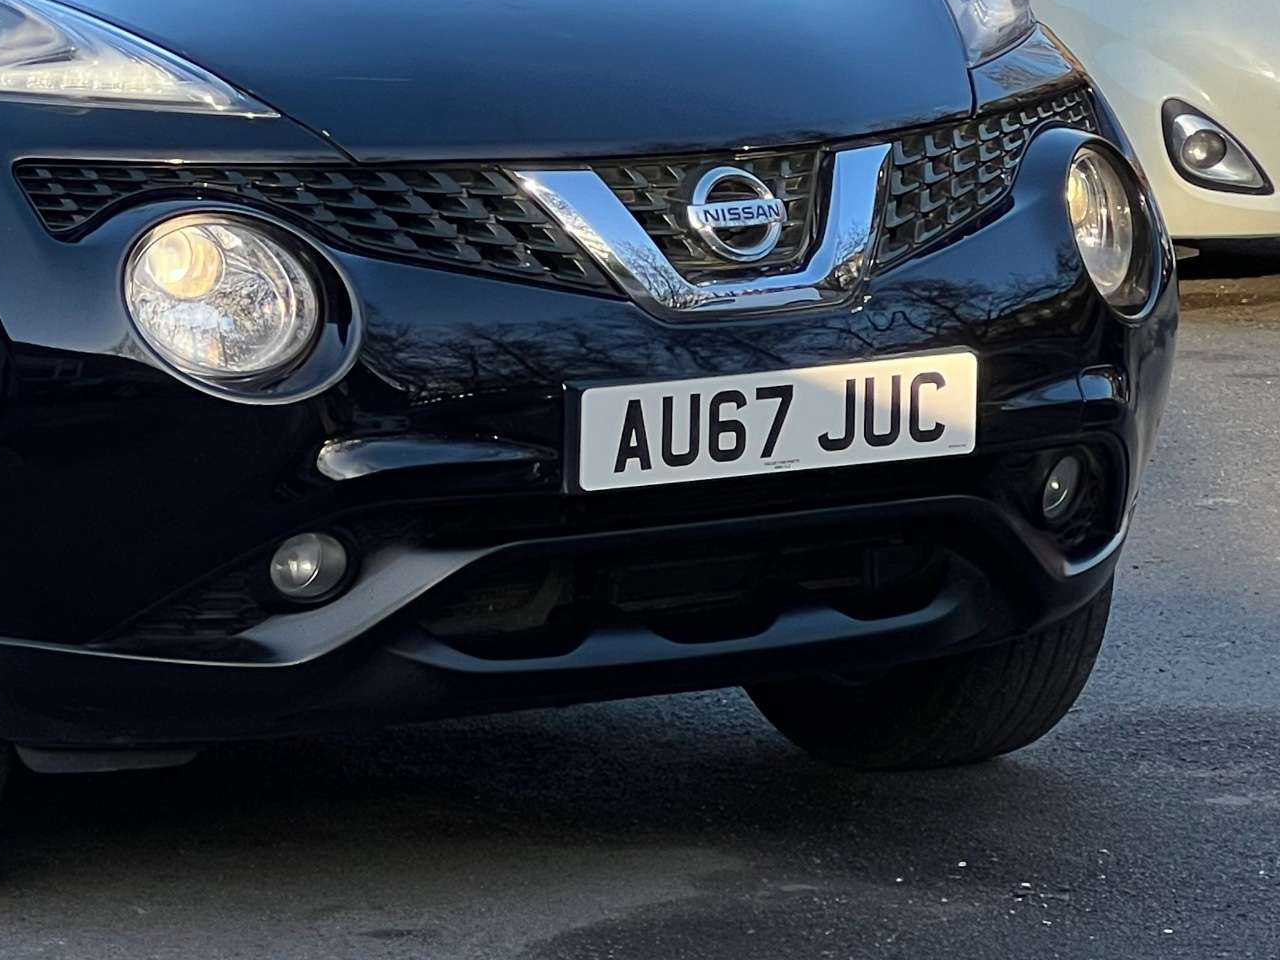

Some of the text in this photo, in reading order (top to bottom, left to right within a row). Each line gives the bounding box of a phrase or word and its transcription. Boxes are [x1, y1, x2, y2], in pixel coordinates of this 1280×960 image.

[703, 203, 780, 223] NISSAN
[614, 371, 947, 473] AU67 JUC
